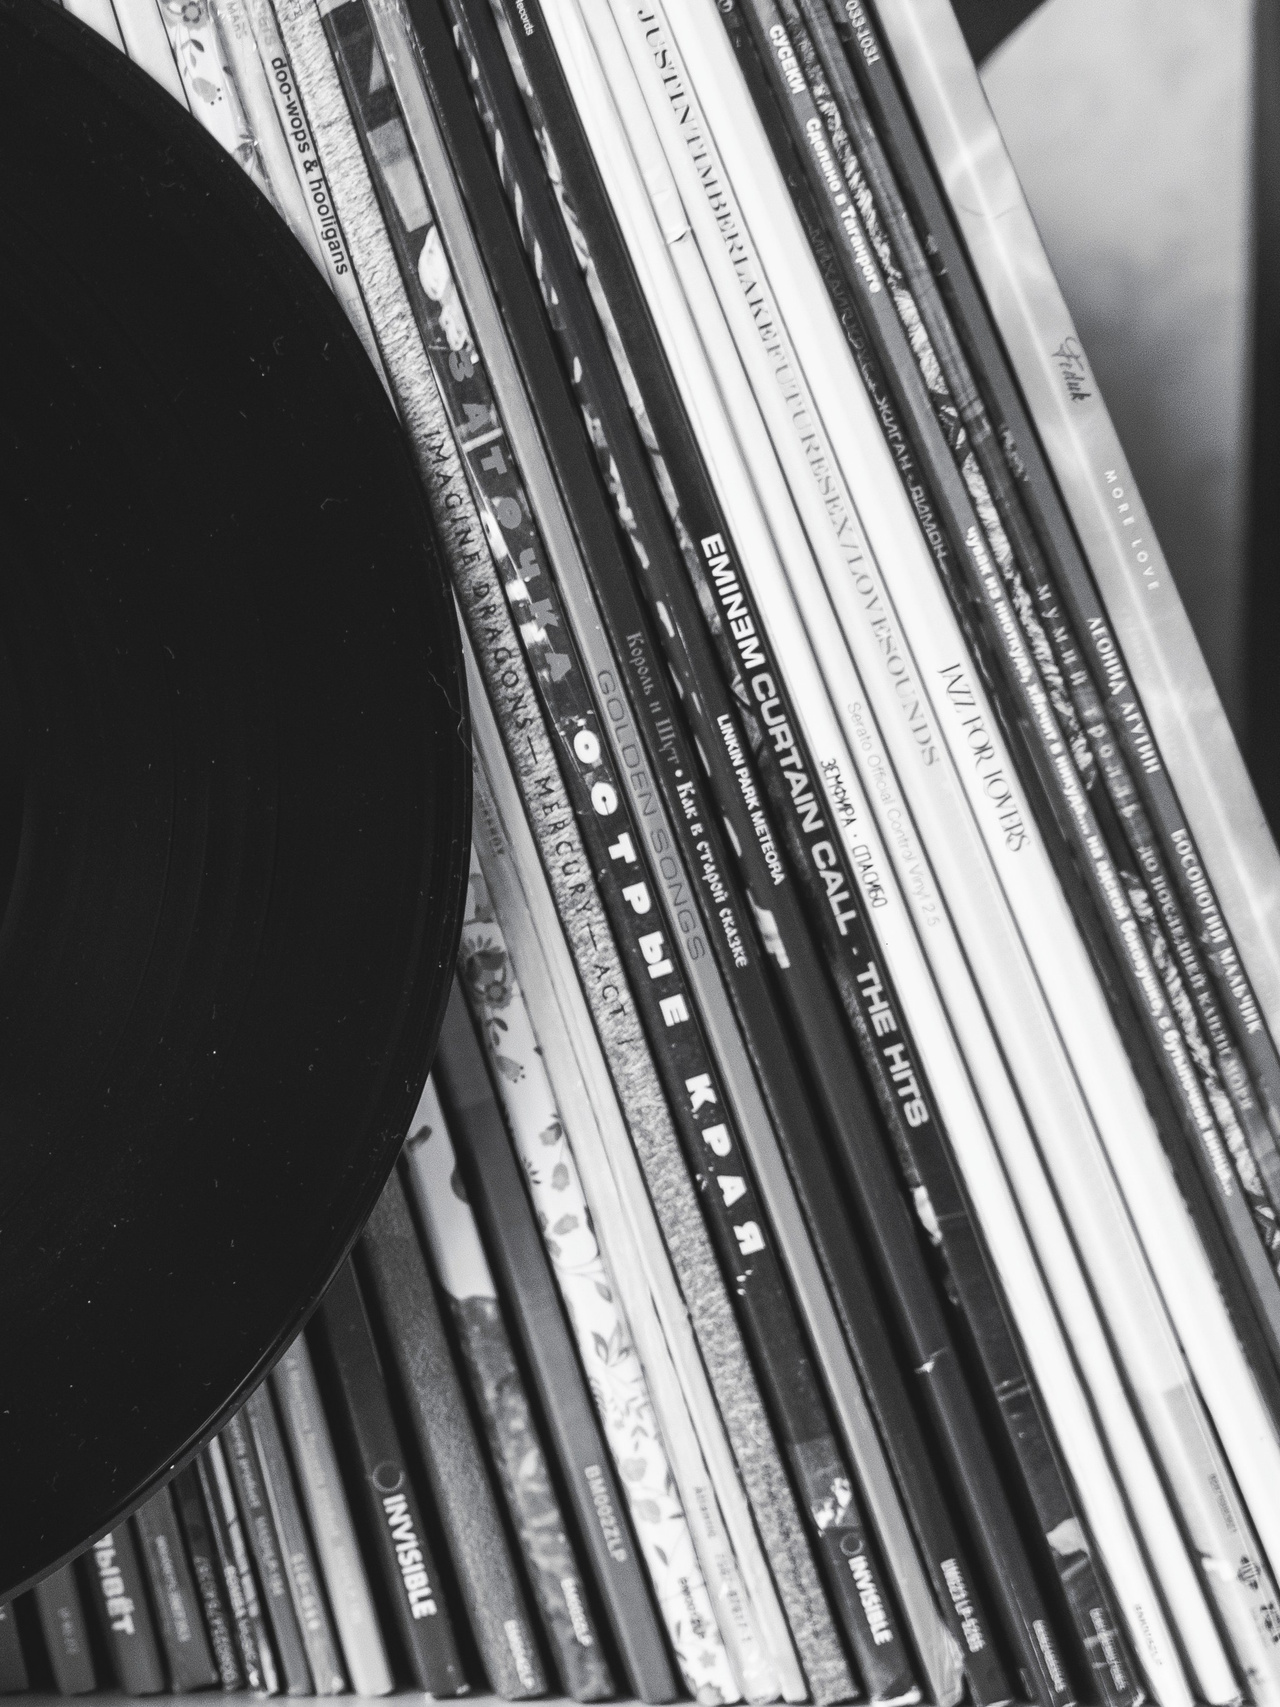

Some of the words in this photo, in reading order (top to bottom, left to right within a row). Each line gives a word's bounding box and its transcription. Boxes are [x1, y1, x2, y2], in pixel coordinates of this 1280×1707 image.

[266, 55, 313, 155] doo-wops
[767, 22, 806, 94] СУСЕКИ
[301, 157, 319, 174] &
[634, 5, 695, 126] JUSTIN
[681, 126, 779, 342] TIMBERLAKE
[802, 115, 845, 193] Сделано
[834, 192, 848, 206] в
[304, 177, 352, 276] hooligans
[836, 204, 884, 295] Таганроге
[1103, 468, 1135, 526] MORE
[1130, 538, 1160, 591] LOVE
[622, 630, 659, 697] Король
[647, 700, 661, 714] и
[422, 429, 481, 566] IMAGINE
[470, 581, 534, 731] DRAGONS
[533, 775, 593, 915] MERCURY
[592, 960, 626, 1020] ACT
[936, 662, 976, 714] JAZZ
[958, 714, 997, 768] FOR
[980, 768, 1032, 854] LOVERS
[595, 668, 657, 817] GOLDEN
[648, 827, 706, 961] SONGS
[675, 779, 703, 819] Как
[689, 822, 703, 836] в
[715, 712, 746, 767] LINKIN
[733, 766, 760, 810] PARK
[748, 809, 787, 885] METEORA
[817, 756, 860, 828] ЗЕМФИРА
[850, 842, 890, 909] СПАСИБО
[845, 700, 877, 752] Serato
[864, 752, 897, 806] Official
[884, 806, 918, 862] Control
[905, 863, 932, 901] Vinyl
[1083, 614, 1130, 696] ЛЕОНИД
[1119, 698, 1161, 774] АГУТИН
[1169, 827, 1228, 945] БОСОНОГИЙ
[1215, 945, 1263, 1035] МАЛЬЧИК
[691, 838, 729, 905] старой
[748, 670, 825, 833] CURTAIN
[808, 838, 862, 936] CALL
[852, 961, 897, 1037] THE
[881, 1042, 930, 1128] HITS
[717, 906, 749, 969] сказке
[569, 726, 691, 1027] ОСТРЫЕ
[684, 1072, 766, 1256] КРАЯ
[382, 1492, 437, 1620] INVISIBLE
[847, 1553, 894, 1646] INVISIBLE
